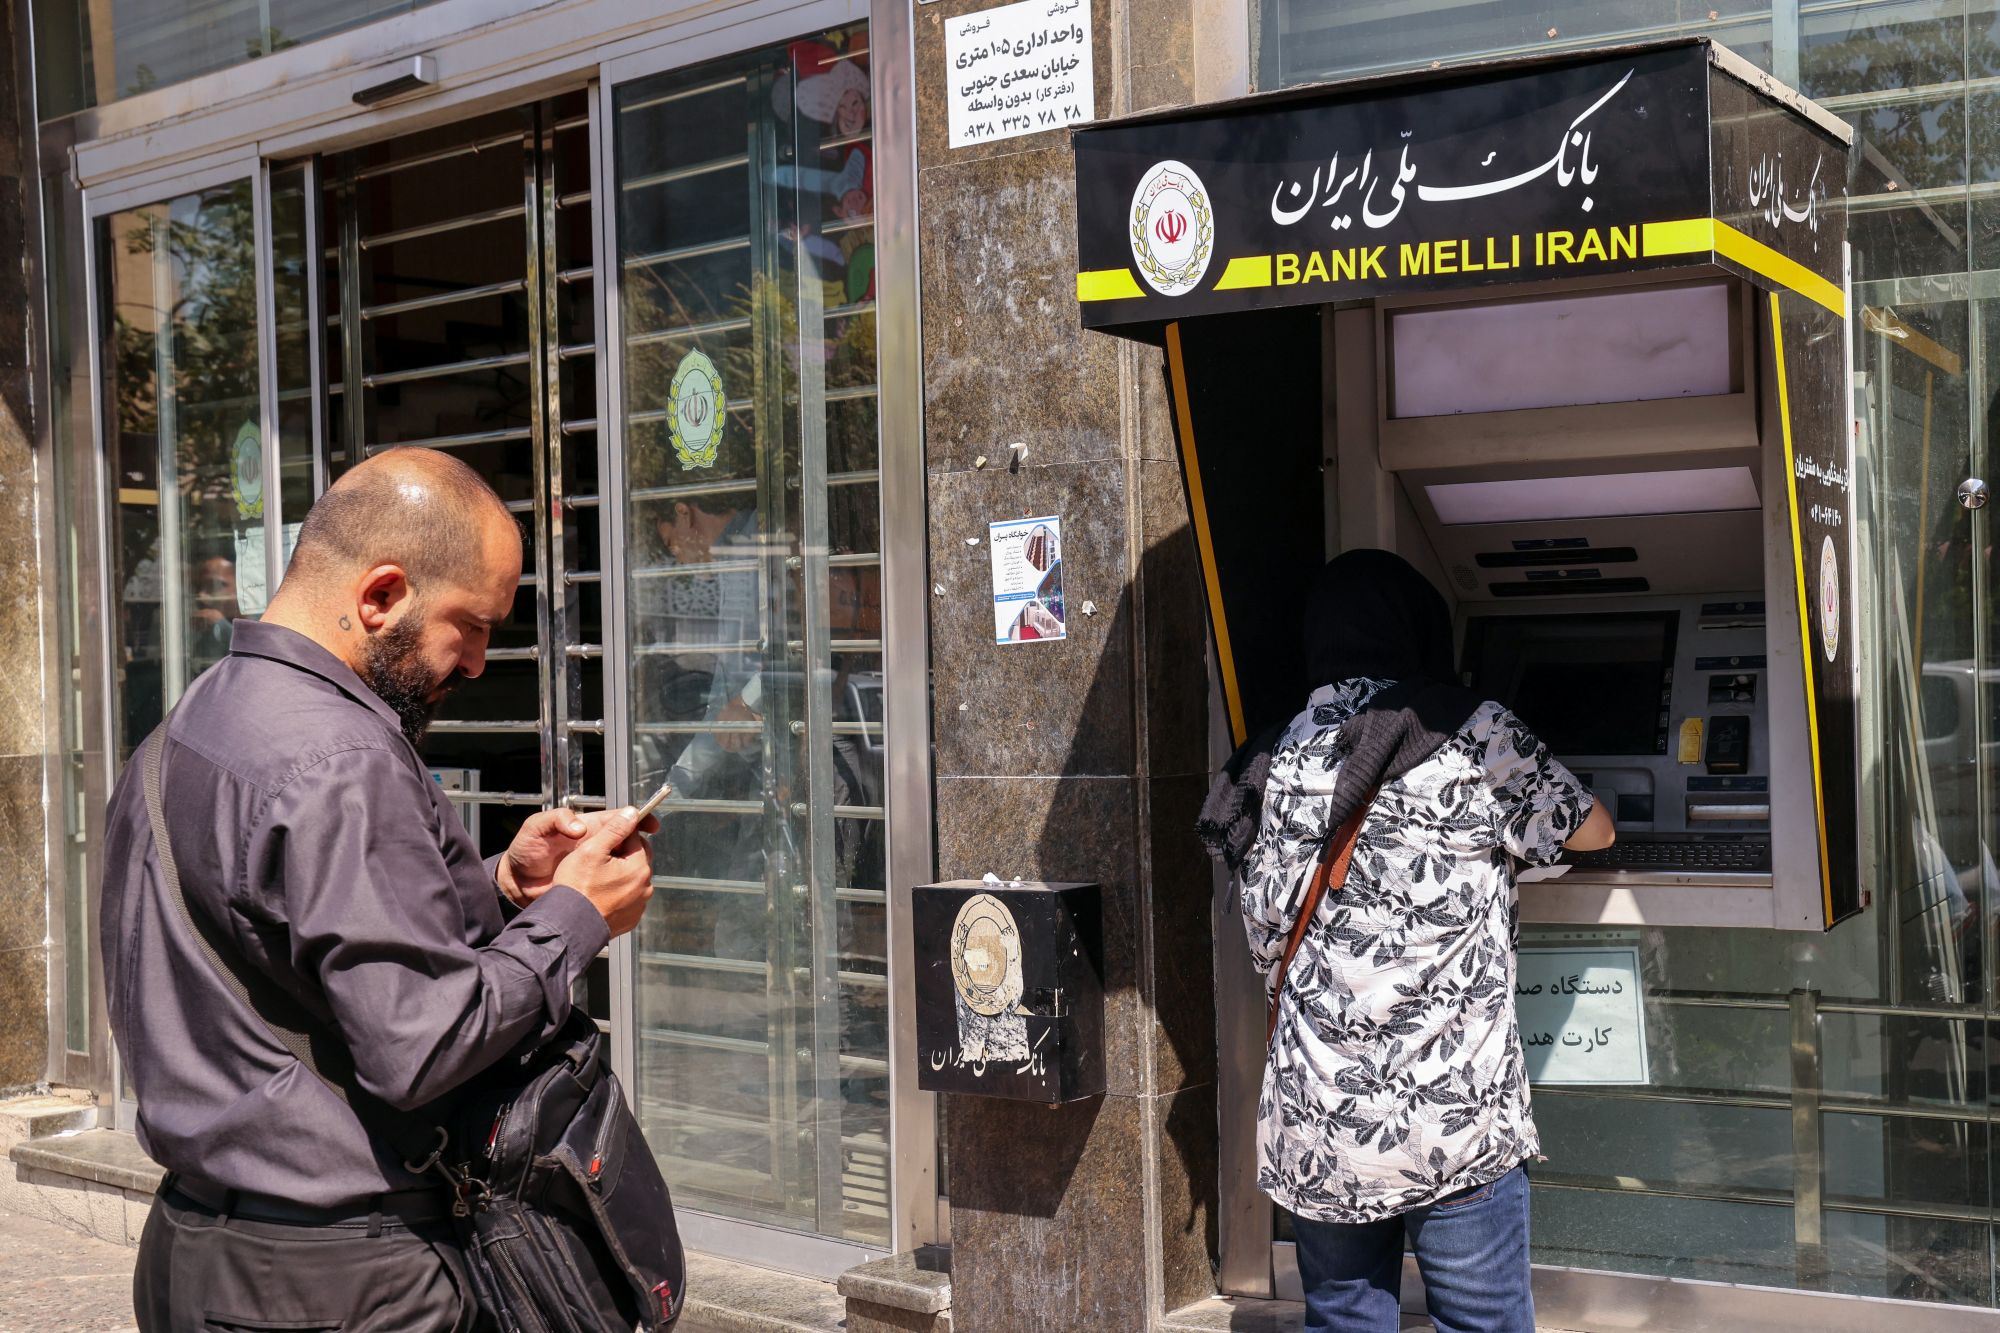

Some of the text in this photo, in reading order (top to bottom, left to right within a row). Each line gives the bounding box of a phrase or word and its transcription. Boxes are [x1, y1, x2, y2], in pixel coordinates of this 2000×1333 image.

[959, 15, 991, 36] فروشی
[955, 23, 1084, 69] واحد اداری ۱۰۵ متری
[961, 53, 1080, 97] خیابان سعدی جنوبی
[967, 95, 1004, 113] واسطه
[1005, 91, 1032, 109] بدون
[963, 103, 1081, 139] ۰۹۳۸ ۳۳۵ ۷۸ ۲۸
[1271, 148, 1373, 231] ایران
[1749, 153, 1775, 222] ایران
[1276, 225, 1638, 286] BANK MELLI IRAN
[1515, 974, 1623, 996] دستگاه صد
[1562, 1027, 1613, 1053] کارت
